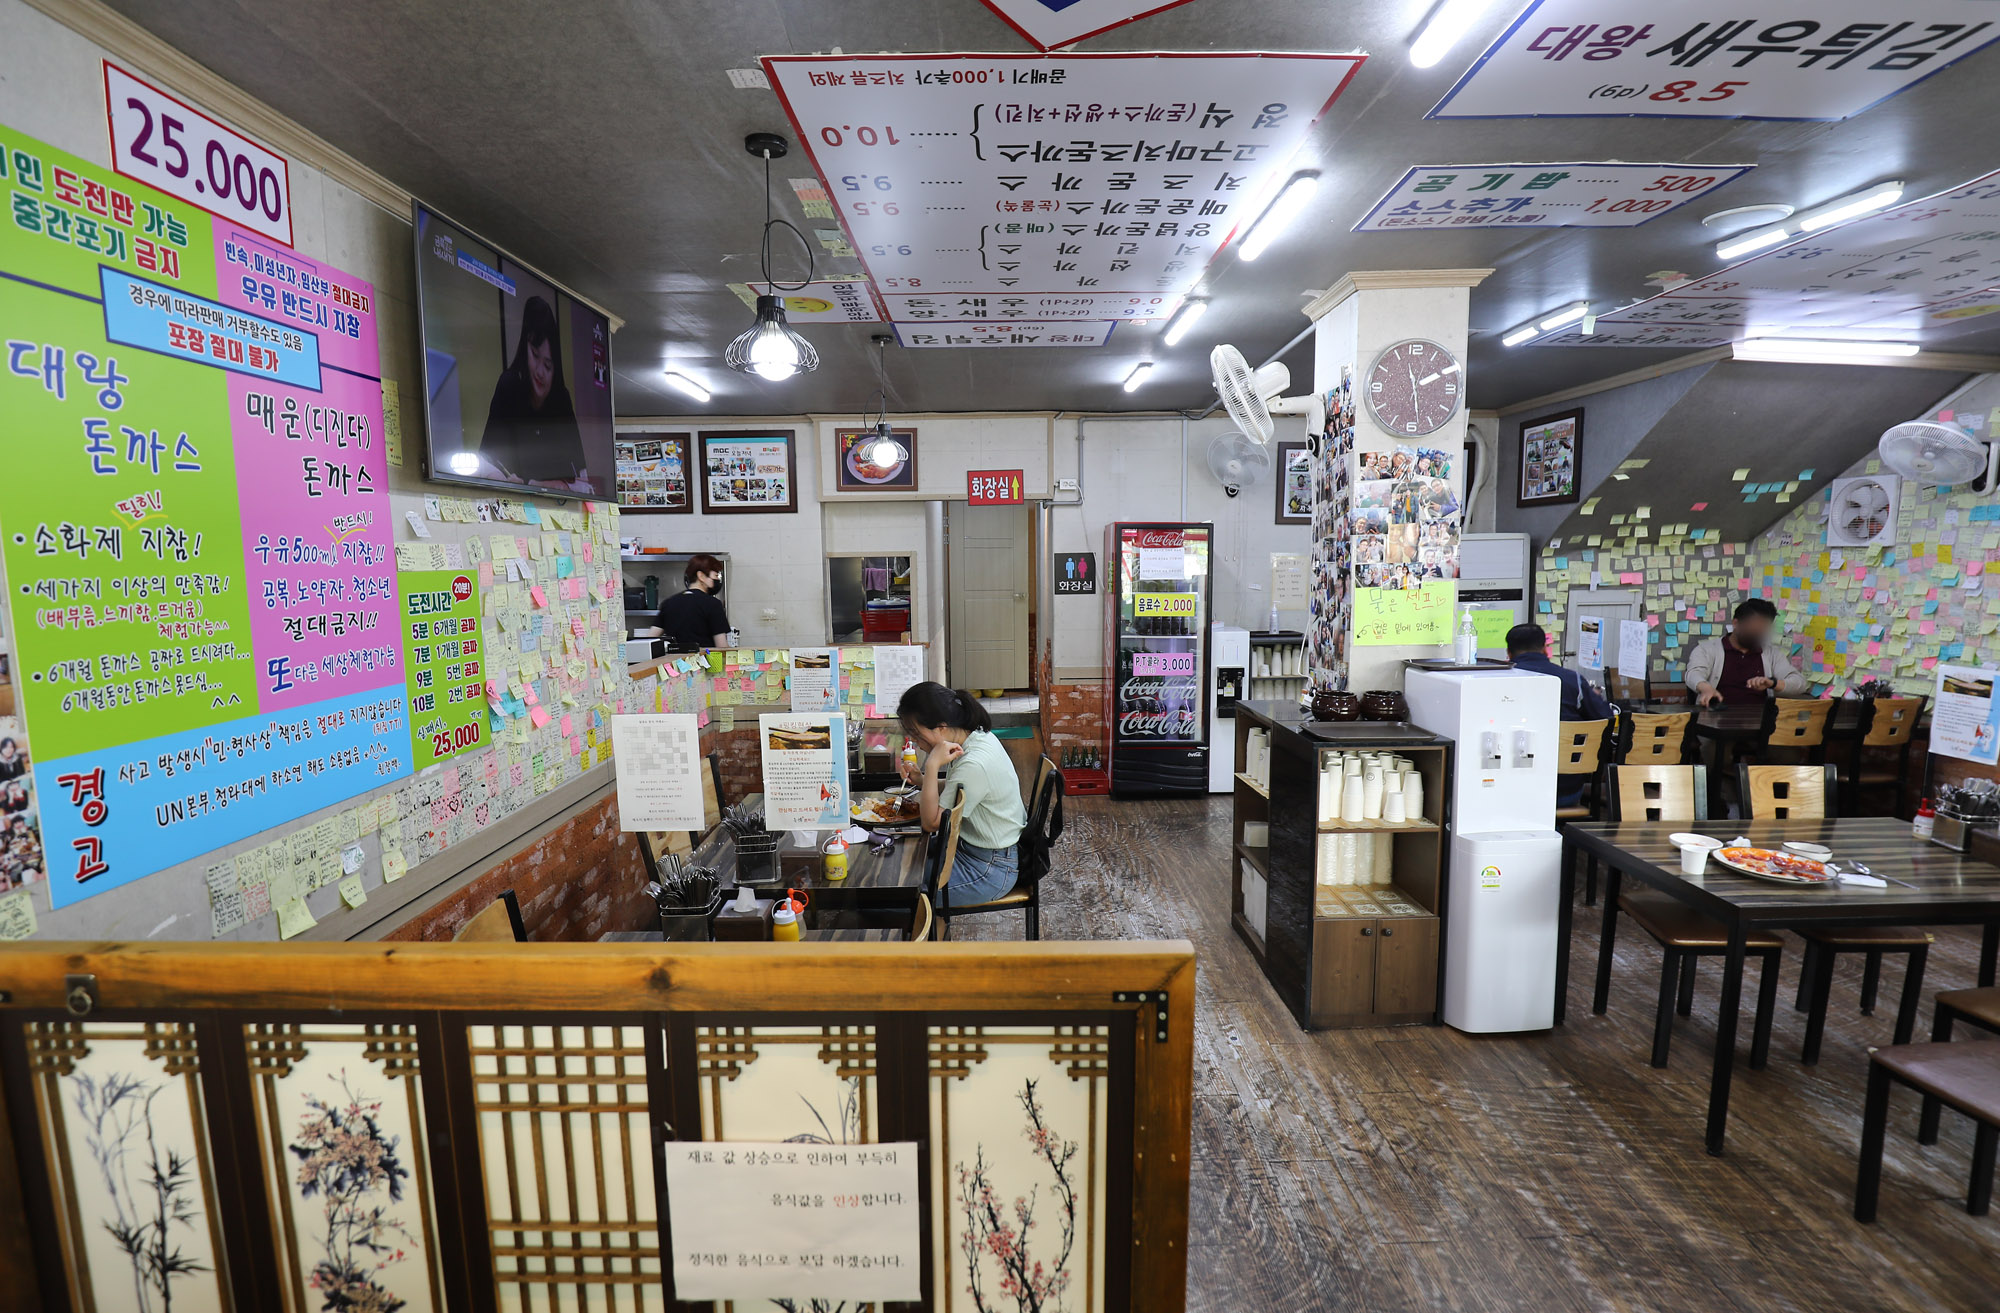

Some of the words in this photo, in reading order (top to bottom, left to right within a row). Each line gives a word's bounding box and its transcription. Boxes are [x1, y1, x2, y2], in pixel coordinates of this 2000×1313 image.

[1526, 23, 1656, 62] 대왕
[1645, 18, 1998, 72] 새우튀김
[808, 70, 845, 87] 제외
[850, 70, 905, 87] 치즈류
[1012, 68, 1066, 85] 곱배기
[1589, 82, 1651, 100] (6p)
[1648, 80, 1750, 103] 8.5
[820, 125, 900, 147] 10.0
[126, 96, 282, 223] 25.000
[996, 139, 1270, 163] 고구마치즈돈까스
[841, 175, 893, 192] 9.5
[1642, 176, 1717, 193] 500
[53, 166, 136, 227] 도전만
[142, 202, 189, 247] 가능
[852, 201, 900, 217] 9.5
[1066, 199, 1229, 216] 매운돈까스
[1387, 195, 1536, 217] 소스추가
[1583, 196, 1674, 215] 1,000
[12, 190, 127, 262] 중간포기
[134, 235, 181, 280] 금지
[871, 244, 913, 257] 9.5
[885, 276, 922, 289] 8.5
[241, 276, 277, 311] 우유
[281, 289, 329, 329] 반드시
[333, 308, 361, 339] 지참
[331, 283, 371, 314] 절대금지
[1128, 297, 1163, 306] 9.0
[128, 283, 173, 314] 경우에
[174, 292, 225, 330] 따라판매
[226, 312, 282, 345] 거부할수도
[283, 330, 304, 352] 있음
[1123, 308, 1157, 317] 9.5
[913, 333, 1041, 347] 새우튀김
[972, 324, 1014, 334] 8.5
[1047, 333, 1096, 344] 대왕
[168, 320, 206, 352] 포장
[209, 332, 244, 365] 절대
[248, 345, 280, 372] 불가
[1408, 343, 1424, 355] 12
[7, 339, 129, 411] 대왕
[1372, 382, 1383, 394] 9
[1445, 383, 1456, 395] 3
[1405, 421, 1417, 433] 6
[83, 416, 201, 475] 돈까스
[302, 454, 375, 497] 돈까스
[969, 476, 1010, 500] 화장실
[116, 490, 163, 519] 필히!
[333, 510, 374, 533] 반드시!
[36, 523, 122, 560] 소화제
[140, 526, 202, 562] 지참!
[341, 540, 386, 567] 지참!!
[36, 578, 101, 602] 세가지
[112, 576, 166, 598] 이상의
[174, 573, 230, 596] 만족감!
[453, 582, 471, 595] 20분!
[1058, 580, 1093, 592] 화장실
[408, 590, 452, 615] 도전시간
[1138, 597, 1161, 613] 음료수
[1162, 598, 1194, 613] 2.000
[282, 611, 379, 643] 절대금지!!
[412, 622, 430, 641] 5분
[433, 616, 459, 637] 6개월
[413, 645, 431, 665] 7분
[436, 640, 460, 660] 1개월
[48, 659, 93, 684] 6개월
[99, 653, 141, 679] 돈까스
[149, 647, 185, 672] 공짜로
[267, 655, 295, 694] 또
[294, 661, 319, 682] 다른
[416, 669, 433, 688] 9분
[446, 663, 462, 681] 5번
[1162, 658, 1191, 671] 3.000
[412, 693, 435, 714] 10분
[448, 685, 464, 703] 2번
[1120, 676, 1197, 702] Coca-Cola
[1120, 709, 1196, 736] Coca-Cola
[118, 762, 151, 784] 사고
[316, 710, 346, 736] 절대로
[432, 721, 481, 758] 25,000
[271, 764, 303, 788] 하소연
[306, 757, 326, 777] 해도
[329, 746, 361, 769] 소용없음
[687, 1150, 716, 1164] 재료
[722, 1150, 736, 1165] 값
[743, 1151, 799, 1165] 상승으로
[806, 1151, 848, 1166] 인하여
[855, 1151, 898, 1166] 부득히
[771, 1193, 825, 1208] 음식값을
[688, 1253, 729, 1267] 정직한
[736, 1254, 791, 1268] 음식으로
[798, 1254, 825, 1267] 보답
[832, 1254, 905, 1268] 하겠습니다.
